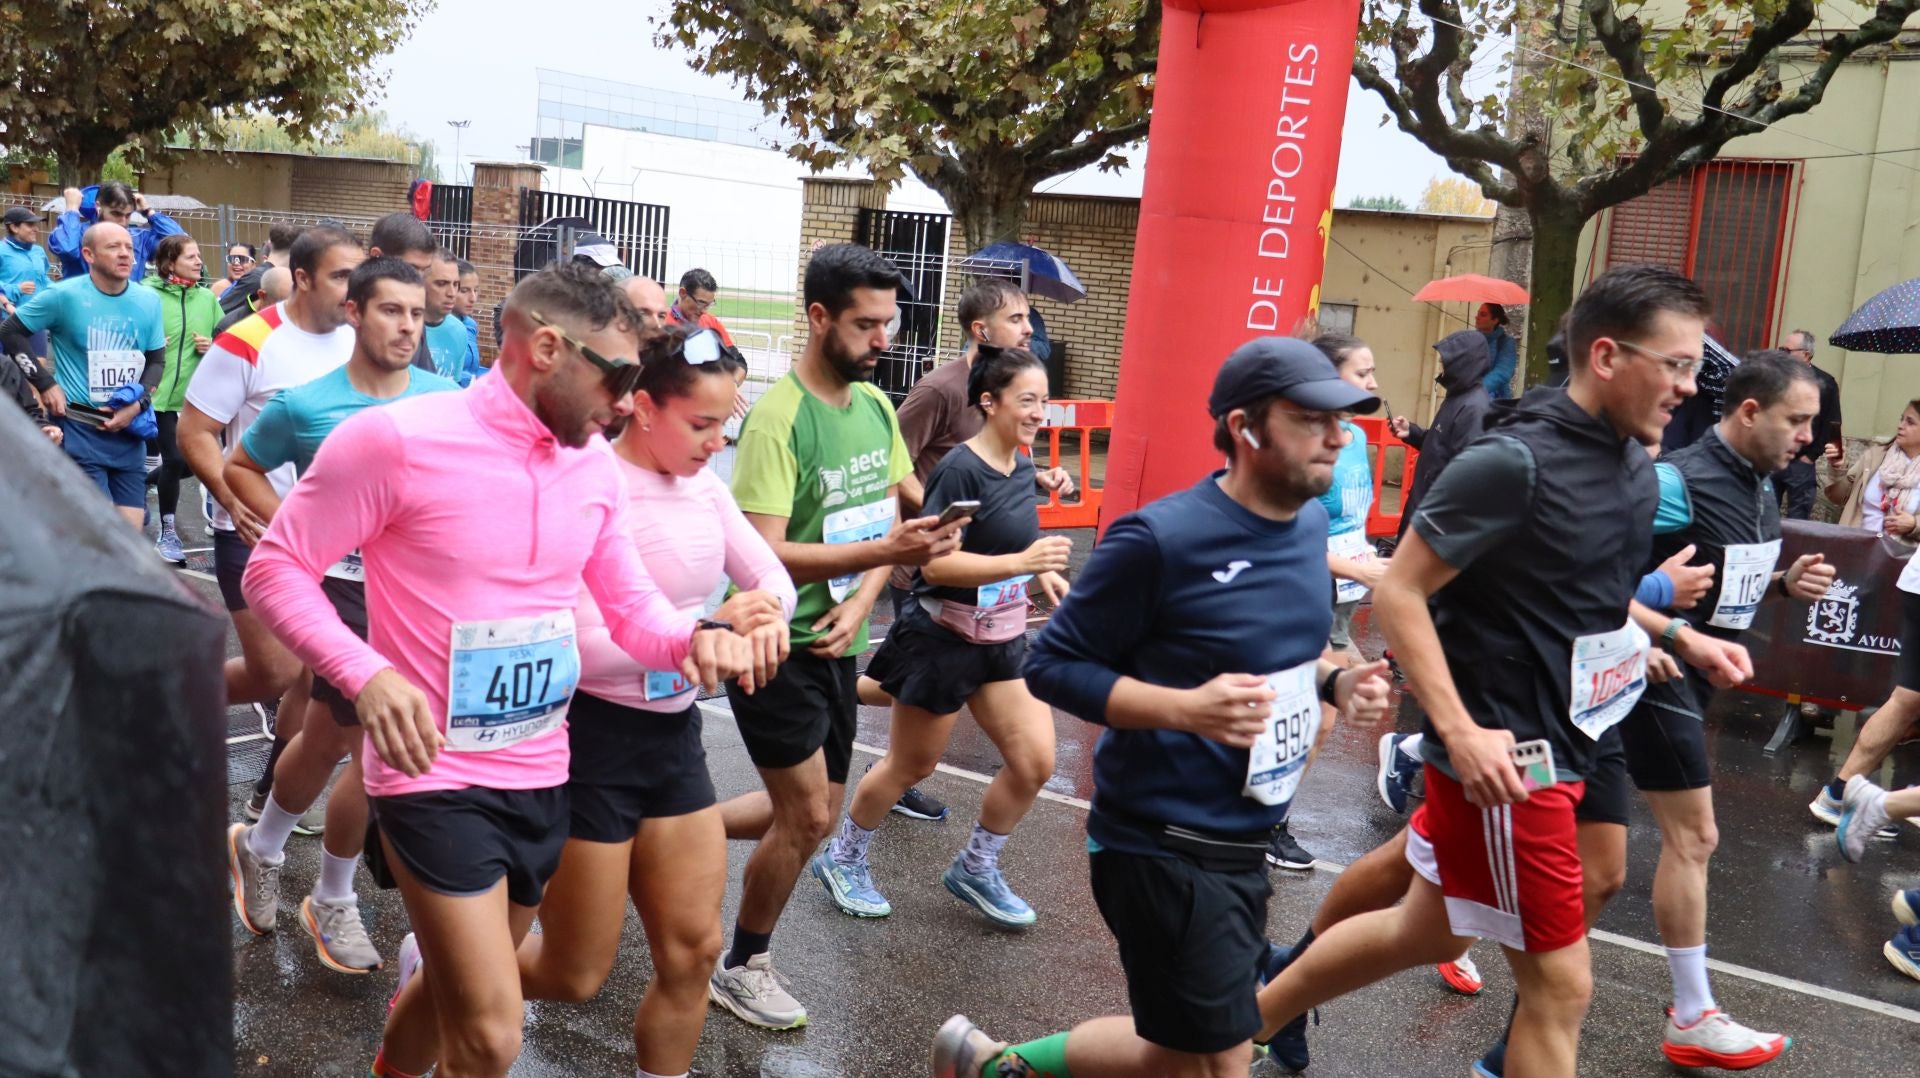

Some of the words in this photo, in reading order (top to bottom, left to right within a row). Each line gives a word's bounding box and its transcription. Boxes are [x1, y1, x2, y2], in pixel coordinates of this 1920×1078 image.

[1258, 43, 1318, 258] DEPORTES
[1247, 277, 1283, 330] DE
[101, 367, 136, 387] 1043
[850, 448, 888, 475] aecc
[485, 657, 553, 711] 407
[1275, 707, 1310, 764] 992
